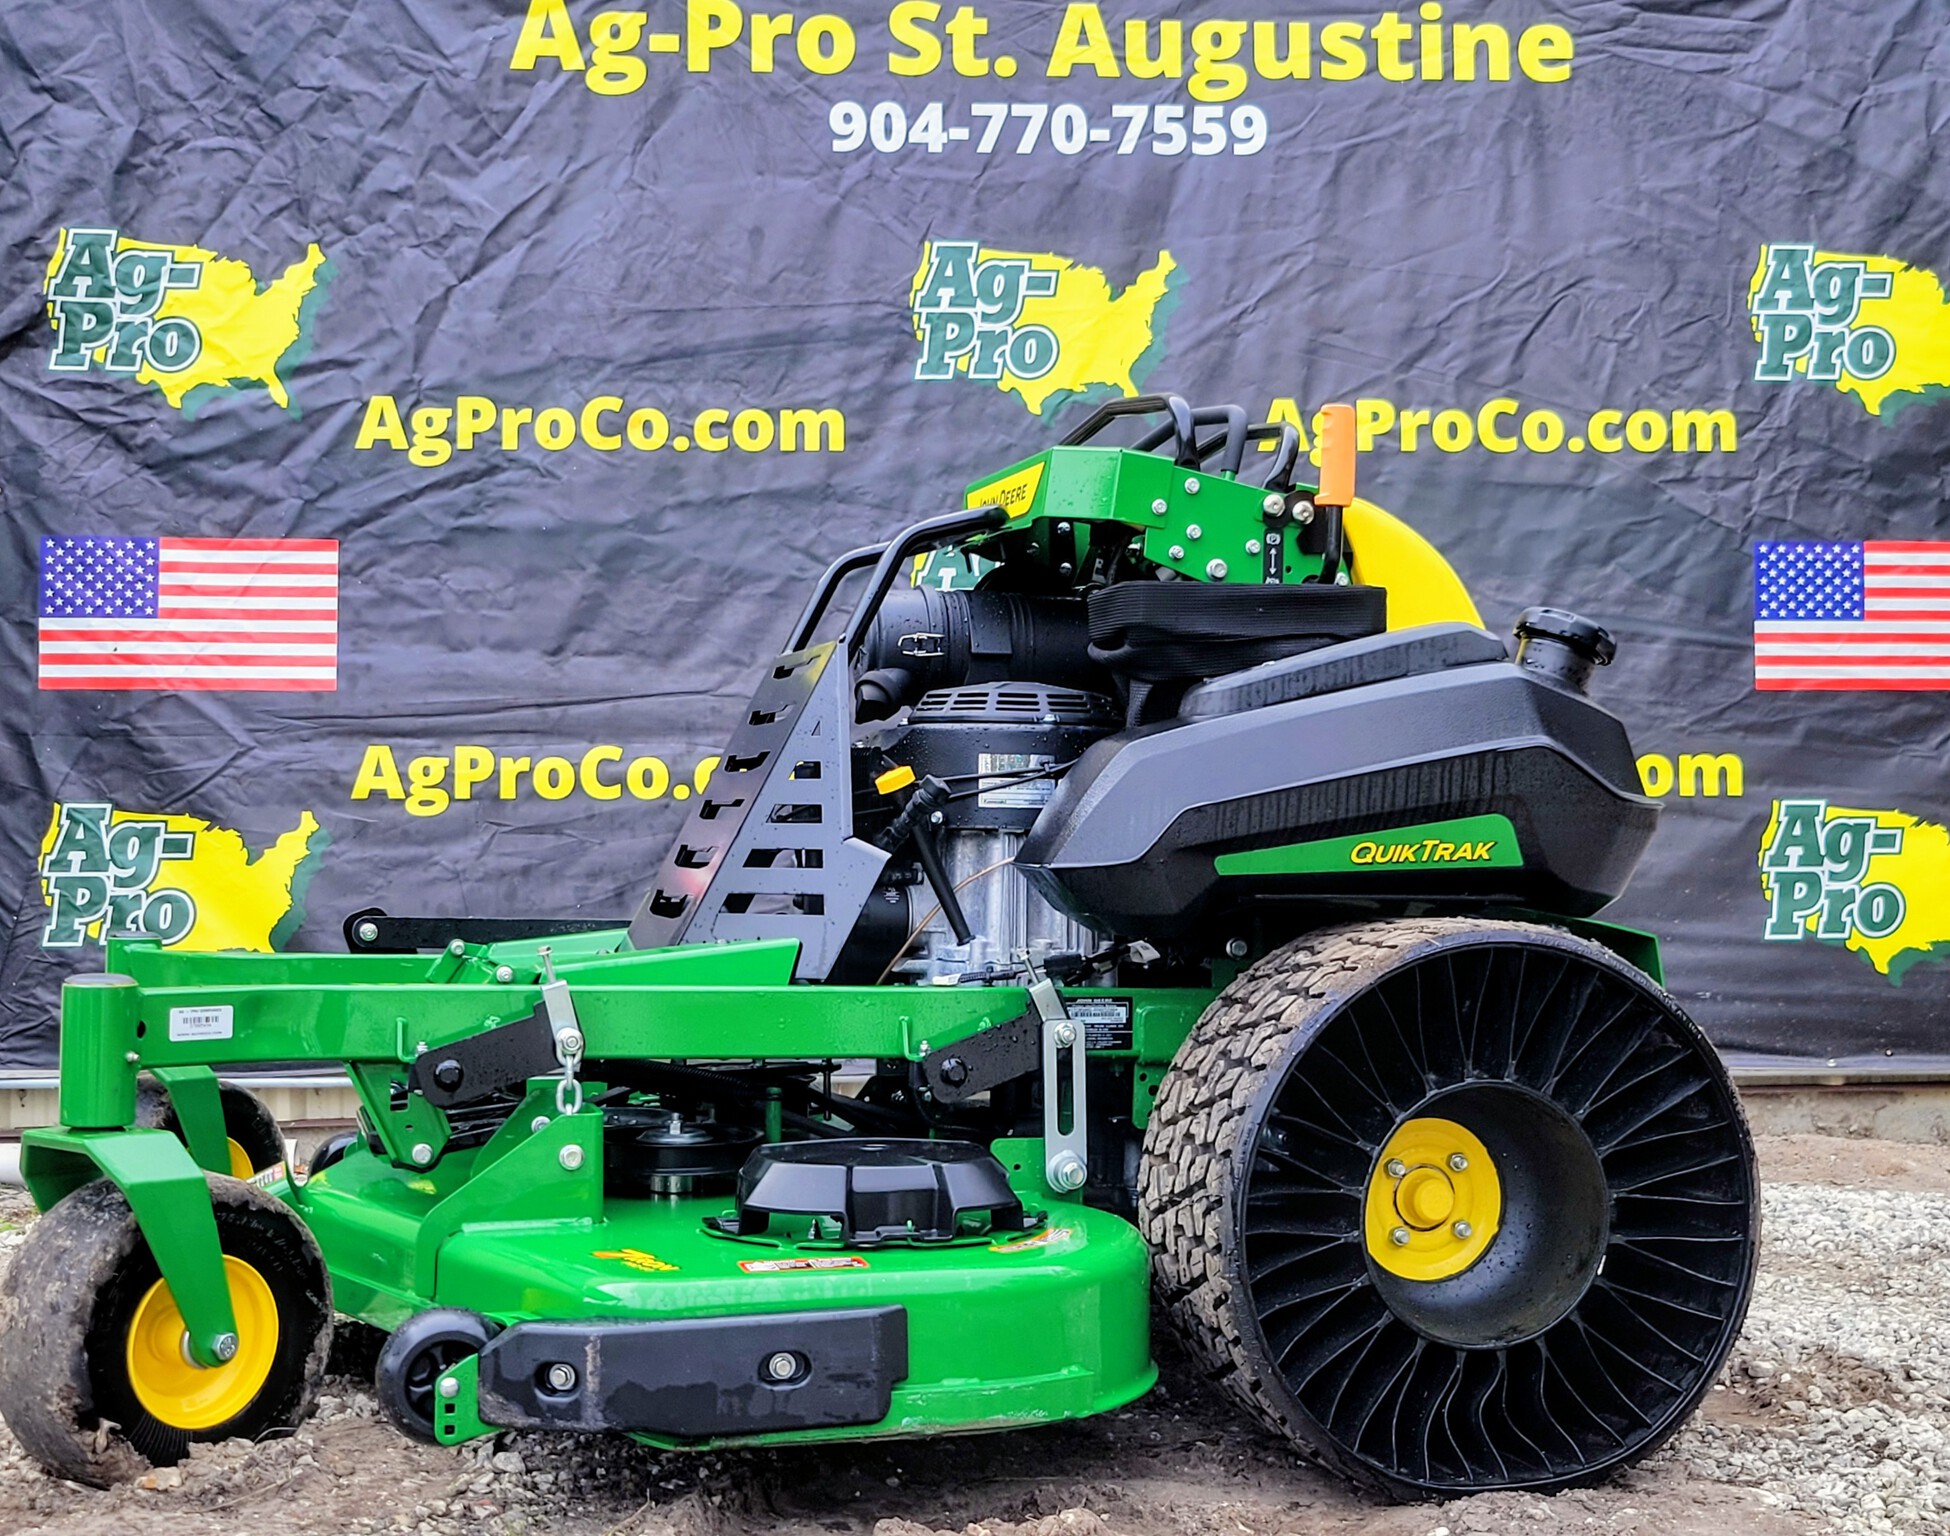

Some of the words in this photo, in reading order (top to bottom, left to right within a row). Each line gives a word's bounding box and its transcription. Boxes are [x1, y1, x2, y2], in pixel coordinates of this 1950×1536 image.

[511, 0, 857, 96] Ag-Pro
[889, 1, 1017, 78] St.
[1047, 3, 1575, 103] Augustine
[828, 100, 1269, 156] 904-770-7559
[48, 228, 200, 319] Ag-
[914, 241, 1058, 327] Ag-
[1752, 244, 1893, 329] Ag-
[48, 299, 202, 373] Pro
[914, 311, 1059, 380] Pro
[1754, 313, 1897, 381] Pro
[356, 396, 846, 467] AgProCo.com
[1000, 483, 1028, 507] DEERE
[350, 744, 723, 818] AgProCo.c
[43, 803, 195, 890] Ag-
[1762, 799, 1904, 886] Ag-
[42, 875, 195, 947] Pro
[1764, 870, 1906, 940] Pro
